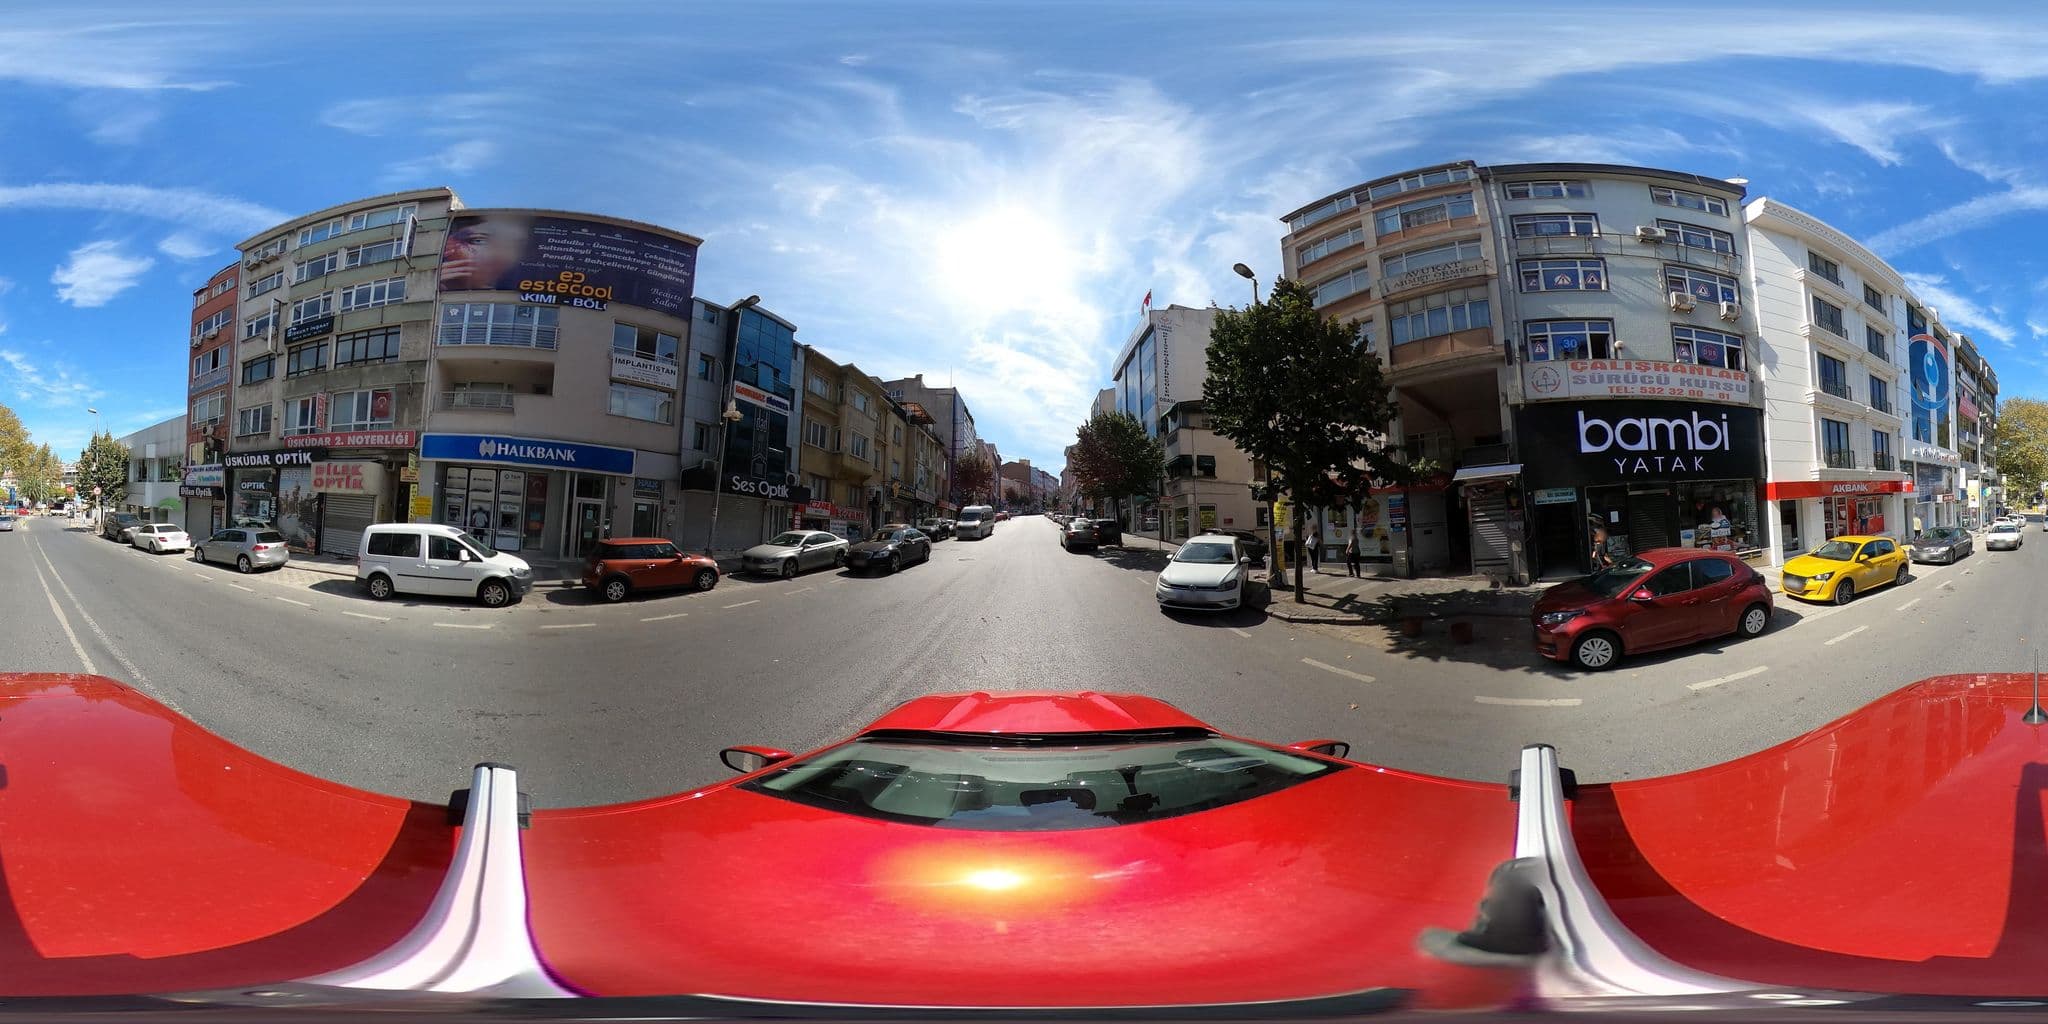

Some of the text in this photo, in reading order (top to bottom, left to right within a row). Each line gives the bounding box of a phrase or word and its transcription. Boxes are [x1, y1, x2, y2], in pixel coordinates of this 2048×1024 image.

[542, 253, 575, 261] Pendik
[1406, 260, 1461, 279] AVUKAT
[519, 280, 613, 300] estecool
[652, 297, 678, 310] Salon
[1563, 339, 1578, 348] 30
[614, 356, 677, 376] IMPLANTISTAN
[1570, 359, 1746, 381] ÇALIŞKANLAR
[1573, 372, 1747, 393] SÜRÜCÜ KURSU
[1639, 386, 1665, 395] 532
[1668, 387, 1684, 396] 32
[287, 430, 409, 448] ÜSKÜDAR 2. NOTERLİĞİ
[1577, 410, 1730, 453] bambi
[225, 450, 313, 467] ÜSKÜDAR OPTİK
[497, 442, 576, 462] HALKBANK
[1614, 456, 1705, 474] YATAK
[732, 475, 789, 499] Ses Optik
[1832, 483, 1869, 493] AKBANK
